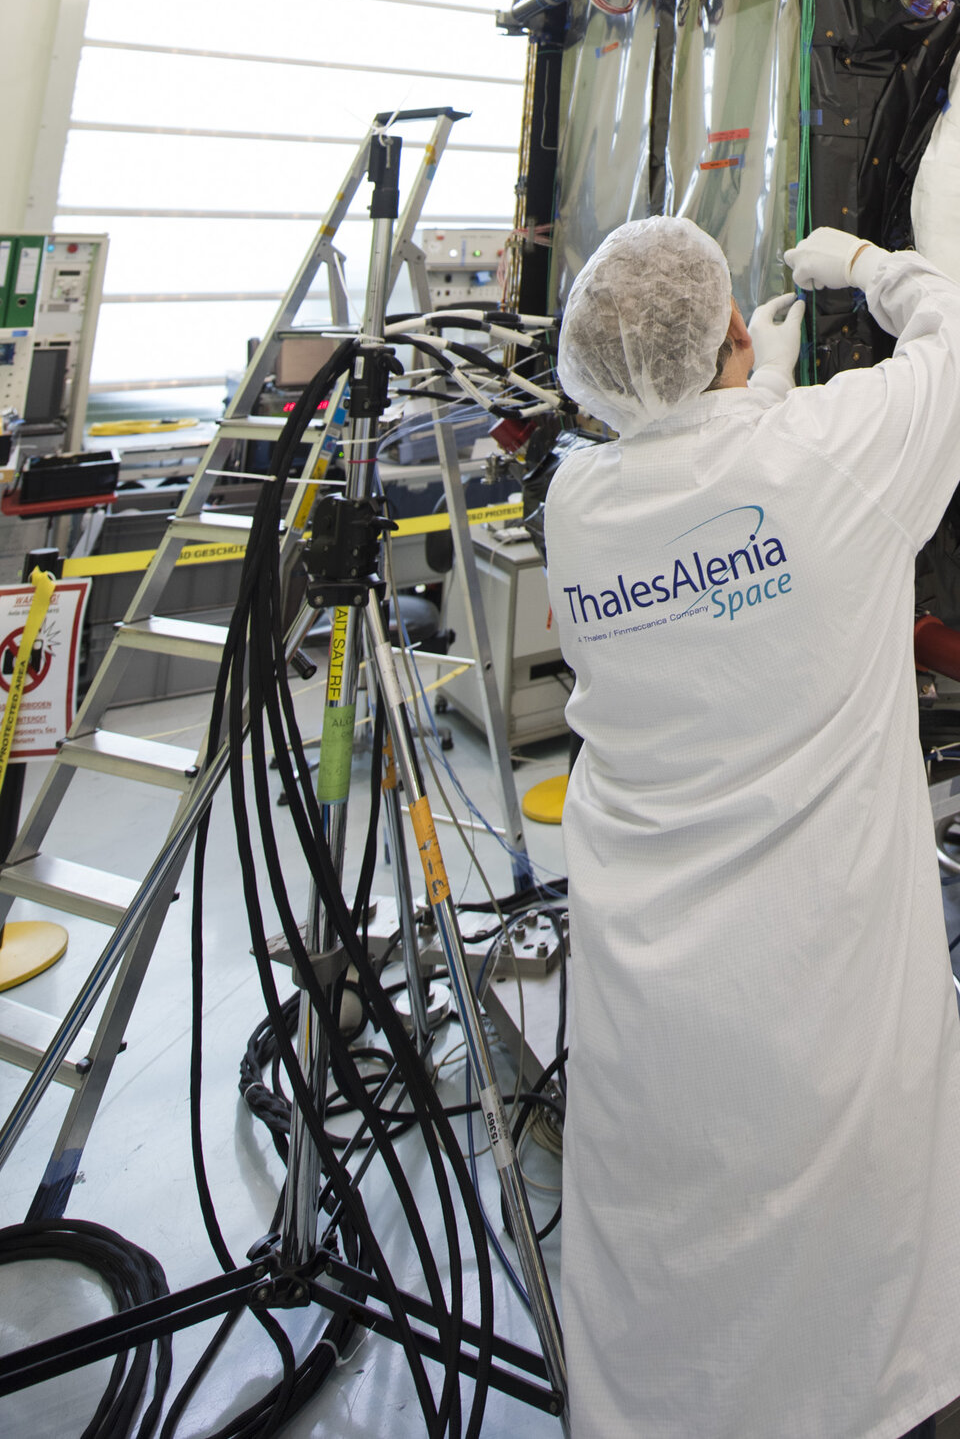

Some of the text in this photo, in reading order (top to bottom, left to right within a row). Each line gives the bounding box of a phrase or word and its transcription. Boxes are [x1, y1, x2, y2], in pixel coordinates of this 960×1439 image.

[563, 534, 788, 624] ThalesAlenia
[711, 572, 793, 621] Space
[584, 632, 608, 643] Thales
[614, 618, 667, 637] Finmeccanica
[669, 604, 709, 622] Company
[329, 608, 348, 698] AIT SAT RF
[15, 660, 26, 691] AREA
[487, 1112, 499, 1146] 15369
